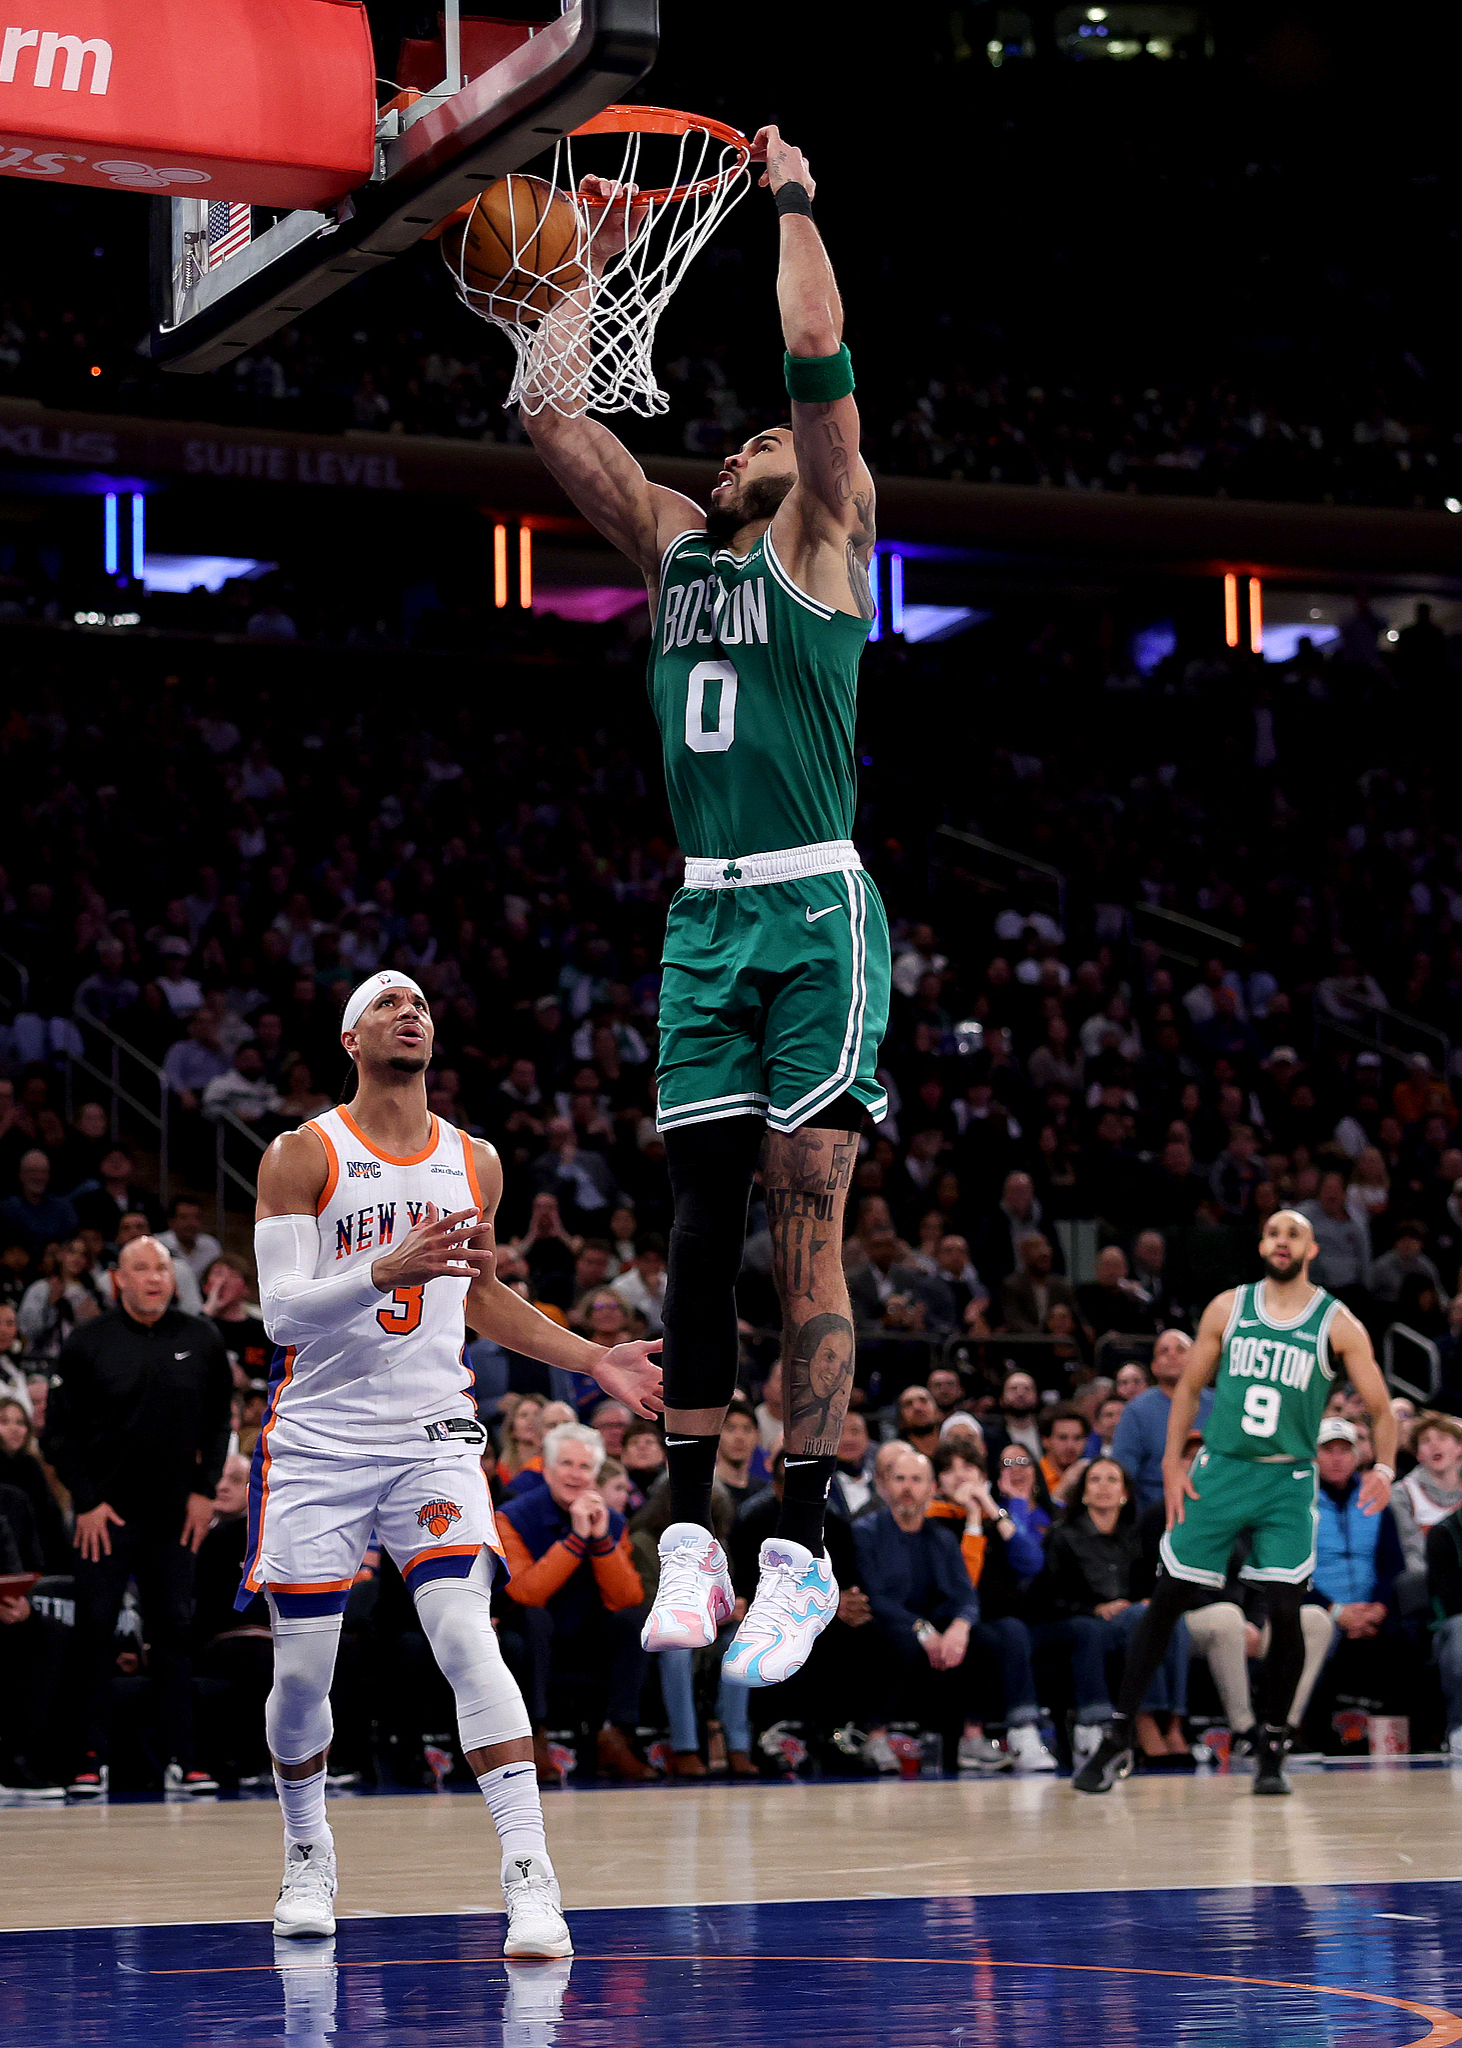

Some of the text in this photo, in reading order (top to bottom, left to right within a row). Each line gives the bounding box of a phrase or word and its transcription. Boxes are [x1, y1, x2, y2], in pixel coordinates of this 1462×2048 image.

[0, 27, 113, 95] rm
[183, 439, 401, 491] SUITE LEVEL
[684, 660, 738, 753] 0
[347, 1161, 382, 1179] NYC
[335, 1201, 397, 1260] NEW
[376, 1284, 426, 1336] 3
[1228, 1335, 1316, 1392] BOSTON
[1241, 1384, 1282, 1438] 9
[417, 1501, 462, 1525] KNICKS
